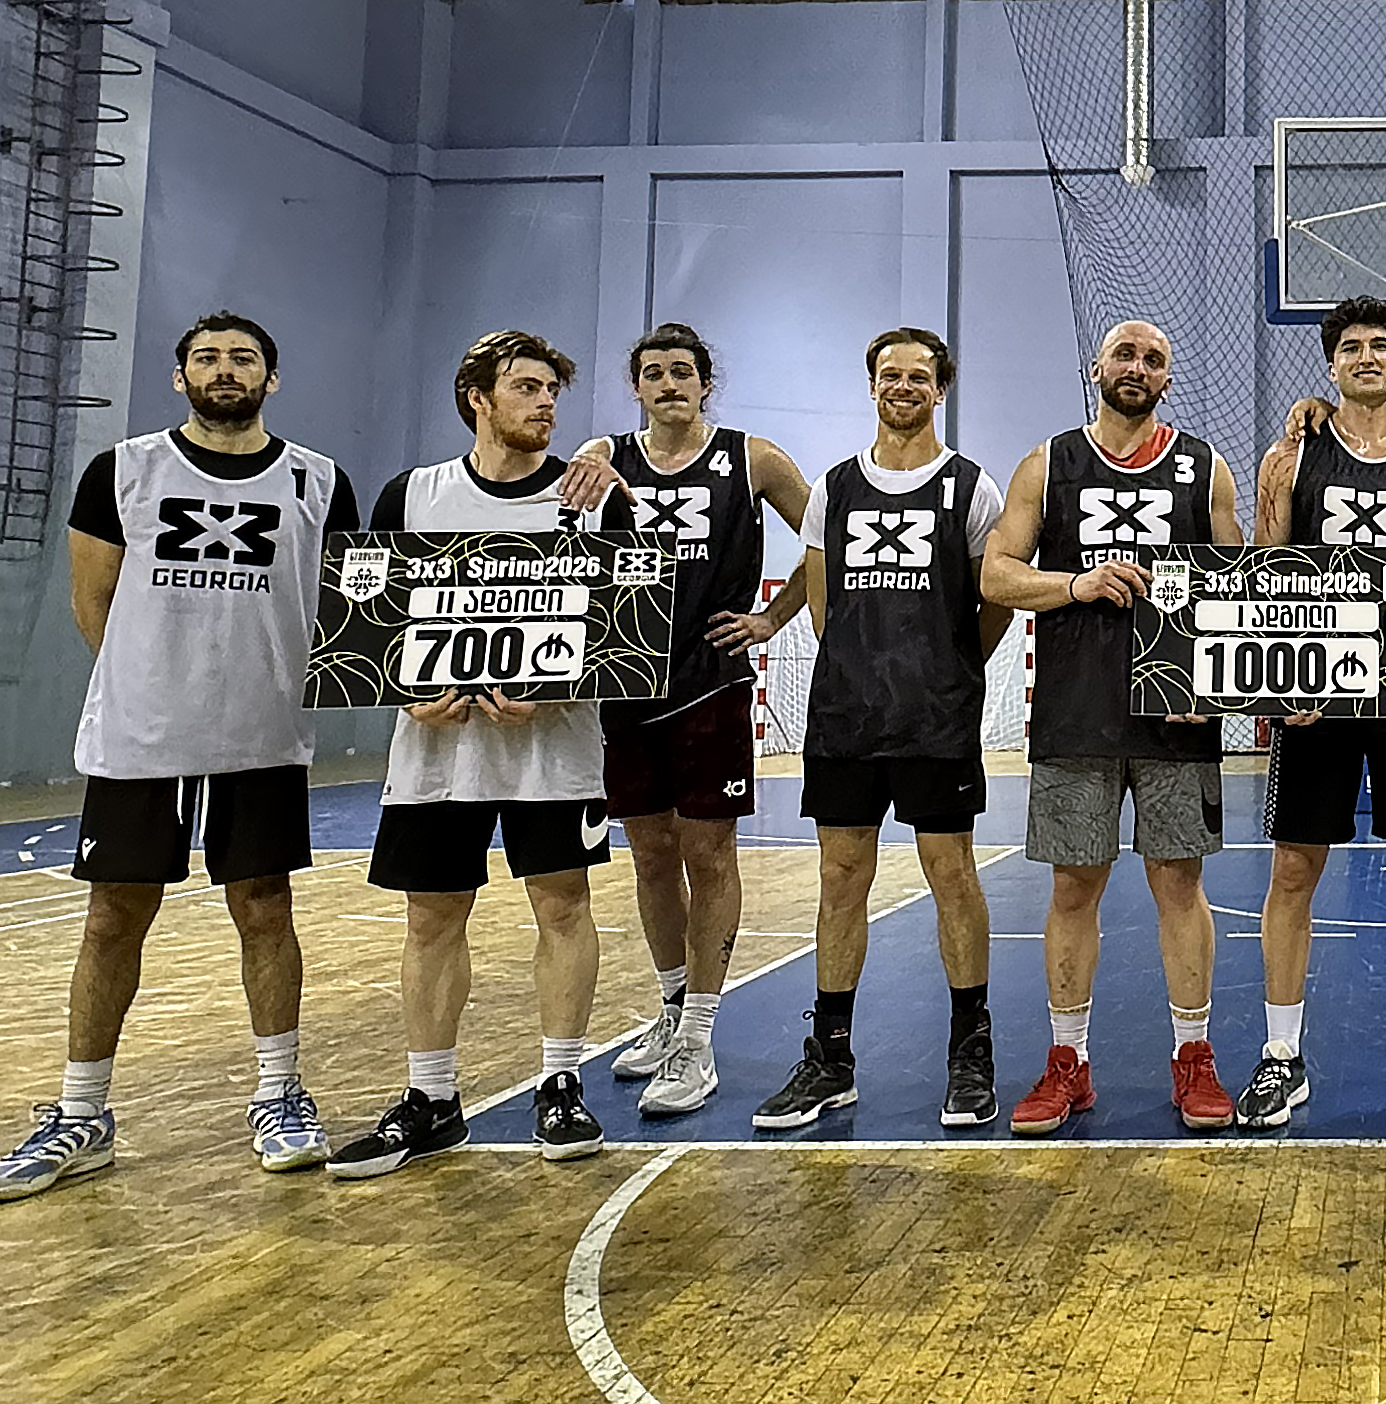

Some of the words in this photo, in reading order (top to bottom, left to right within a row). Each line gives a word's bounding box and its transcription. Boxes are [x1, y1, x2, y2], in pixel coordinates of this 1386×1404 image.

[709, 450, 732, 476] 4
[1175, 454, 1195, 484] 3
[291, 467, 306, 501] 1
[942, 477, 955, 509] 1
[152, 568, 270, 593] GEORGIA
[405, 557, 452, 579] 3x3
[466, 556, 600, 581] Spring2026
[844, 571, 930, 590] GEORGIA
[1205, 571, 1242, 593] 3x3
[1255, 571, 1371, 596] Spring2026
[436, 591, 455, 614] II
[1238, 605, 1243, 627] I
